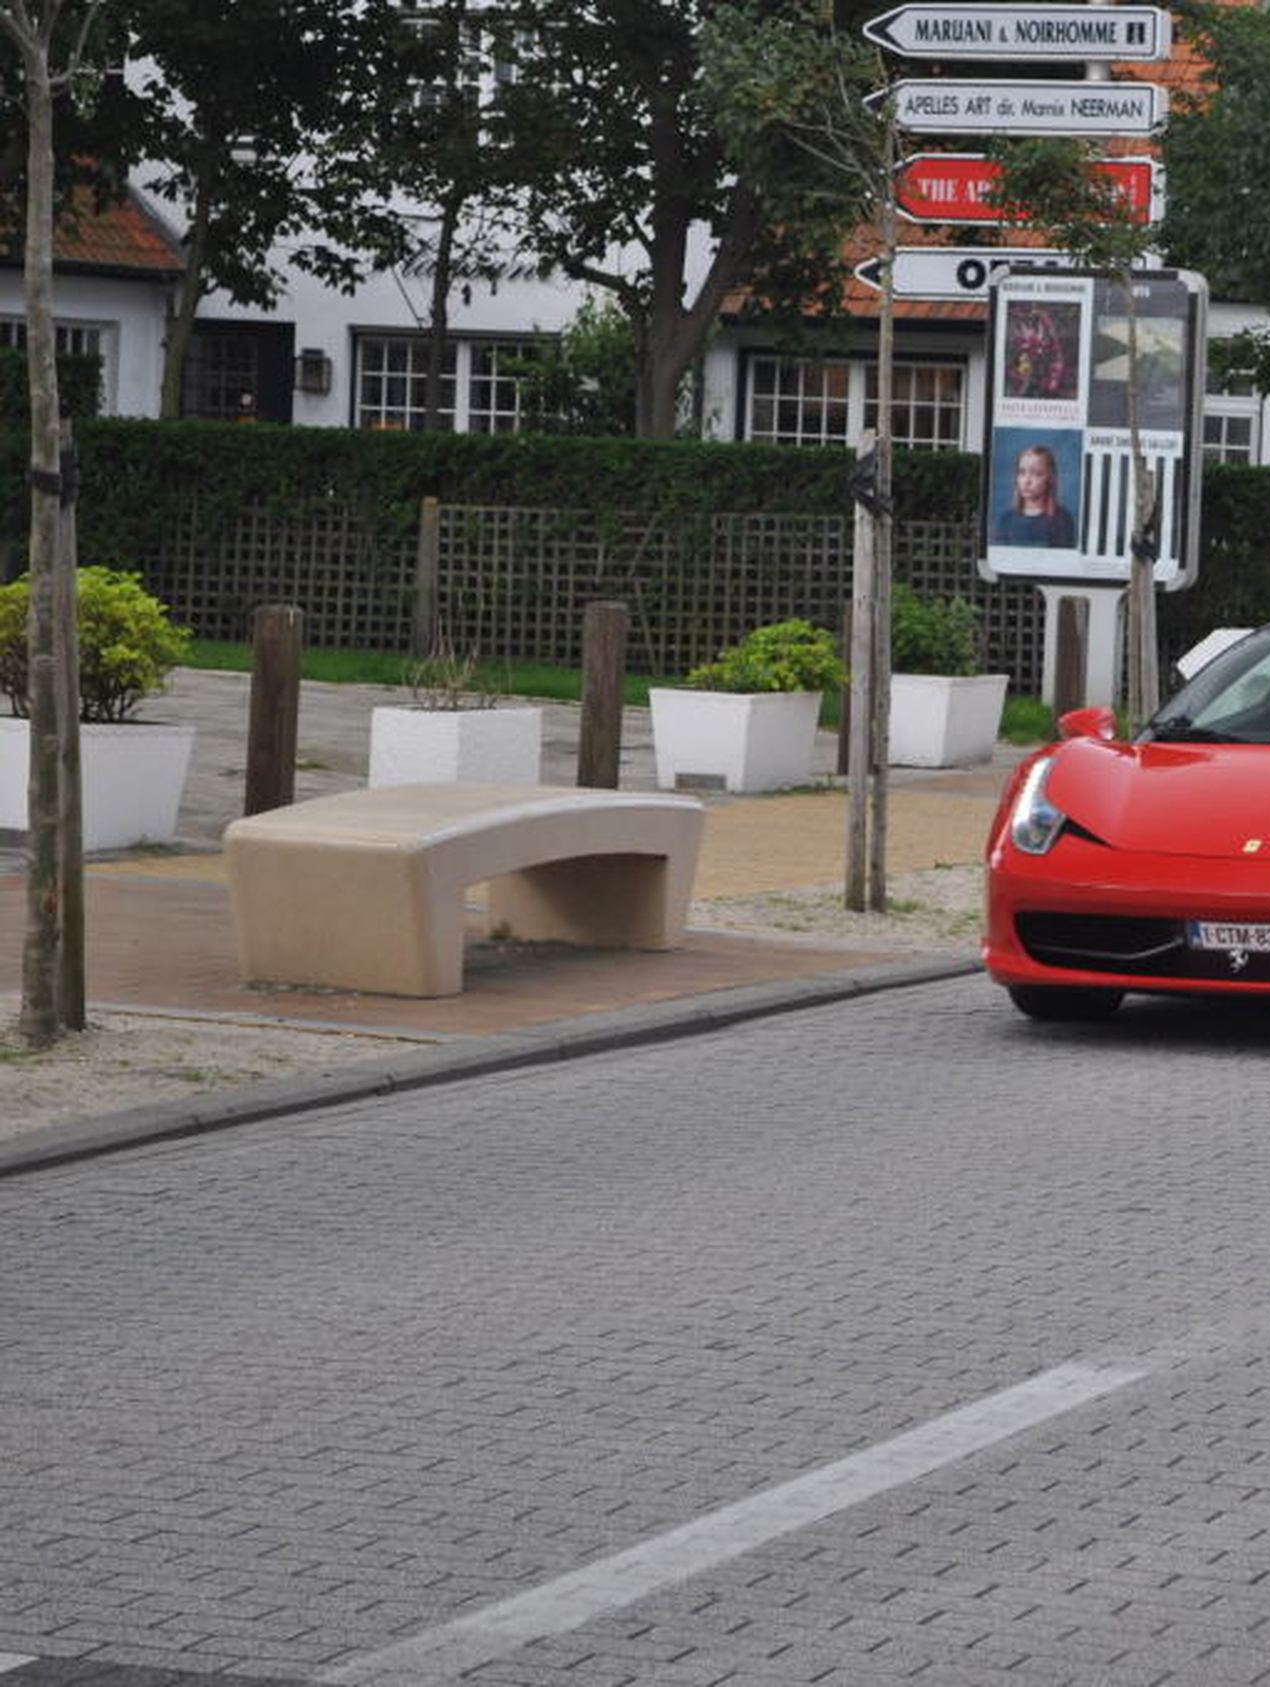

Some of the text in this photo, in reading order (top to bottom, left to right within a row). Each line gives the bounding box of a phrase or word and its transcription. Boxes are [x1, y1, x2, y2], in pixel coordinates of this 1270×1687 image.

[915, 19, 992, 42] MARUANI
[1016, 20, 1117, 44] NOIRHOMME
[905, 96, 959, 116] APELLES
[964, 97, 991, 115] ART
[1071, 99, 1142, 118] NEERMAN
[917, 178, 959, 203] THE
